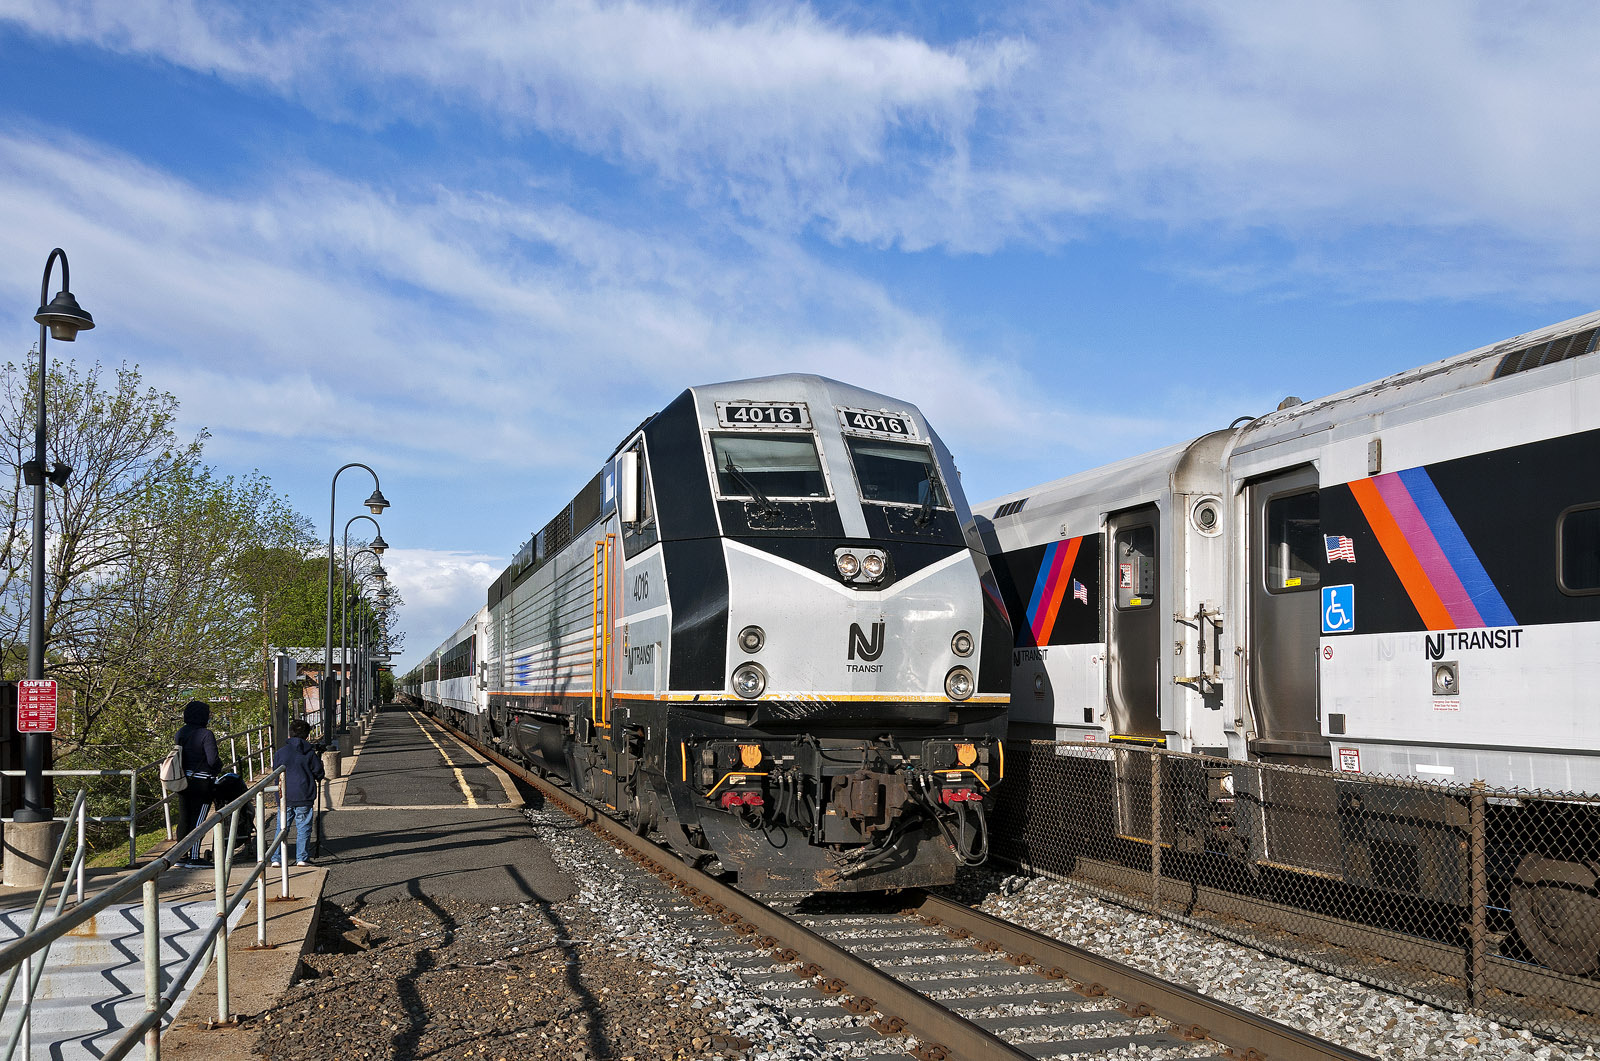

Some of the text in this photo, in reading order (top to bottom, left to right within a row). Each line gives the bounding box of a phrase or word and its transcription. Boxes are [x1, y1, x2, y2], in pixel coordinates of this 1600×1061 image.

[734, 407, 794, 423] 4016
[853, 413, 902, 434] 4016
[633, 570, 649, 602] 4016
[847, 621, 886, 662] NJ
[1425, 633, 1445, 660] NJ
[1447, 629, 1523, 650] TRANSIT
[633, 644, 655, 666] TRANSIT
[1021, 649, 1049, 661] TRANSIT
[846, 664, 883, 673] TRANSIT
